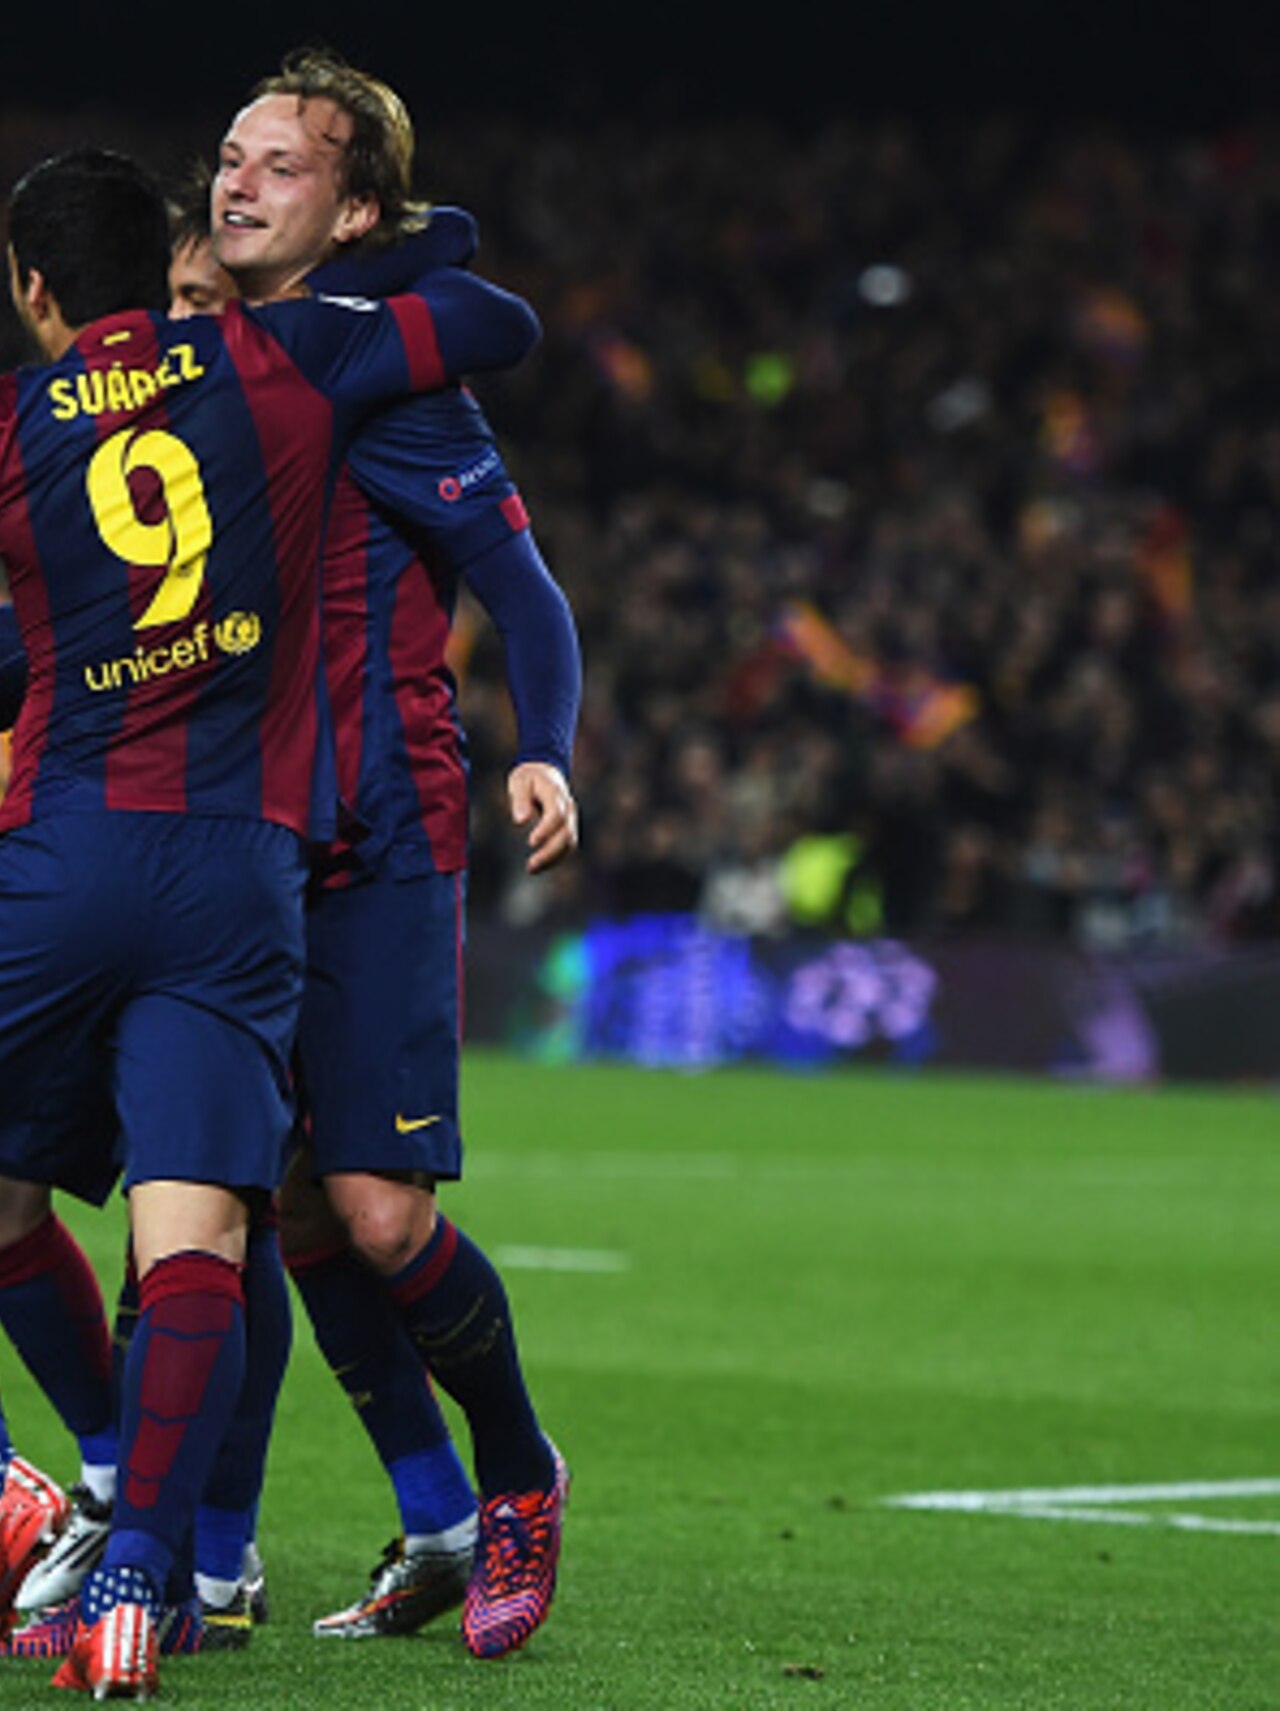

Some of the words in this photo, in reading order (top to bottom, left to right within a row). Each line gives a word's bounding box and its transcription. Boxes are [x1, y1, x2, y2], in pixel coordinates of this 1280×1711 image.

[48, 344, 204, 420] SUÁREZ
[87, 427, 213, 630] 9
[84, 624, 210, 692] unicef
